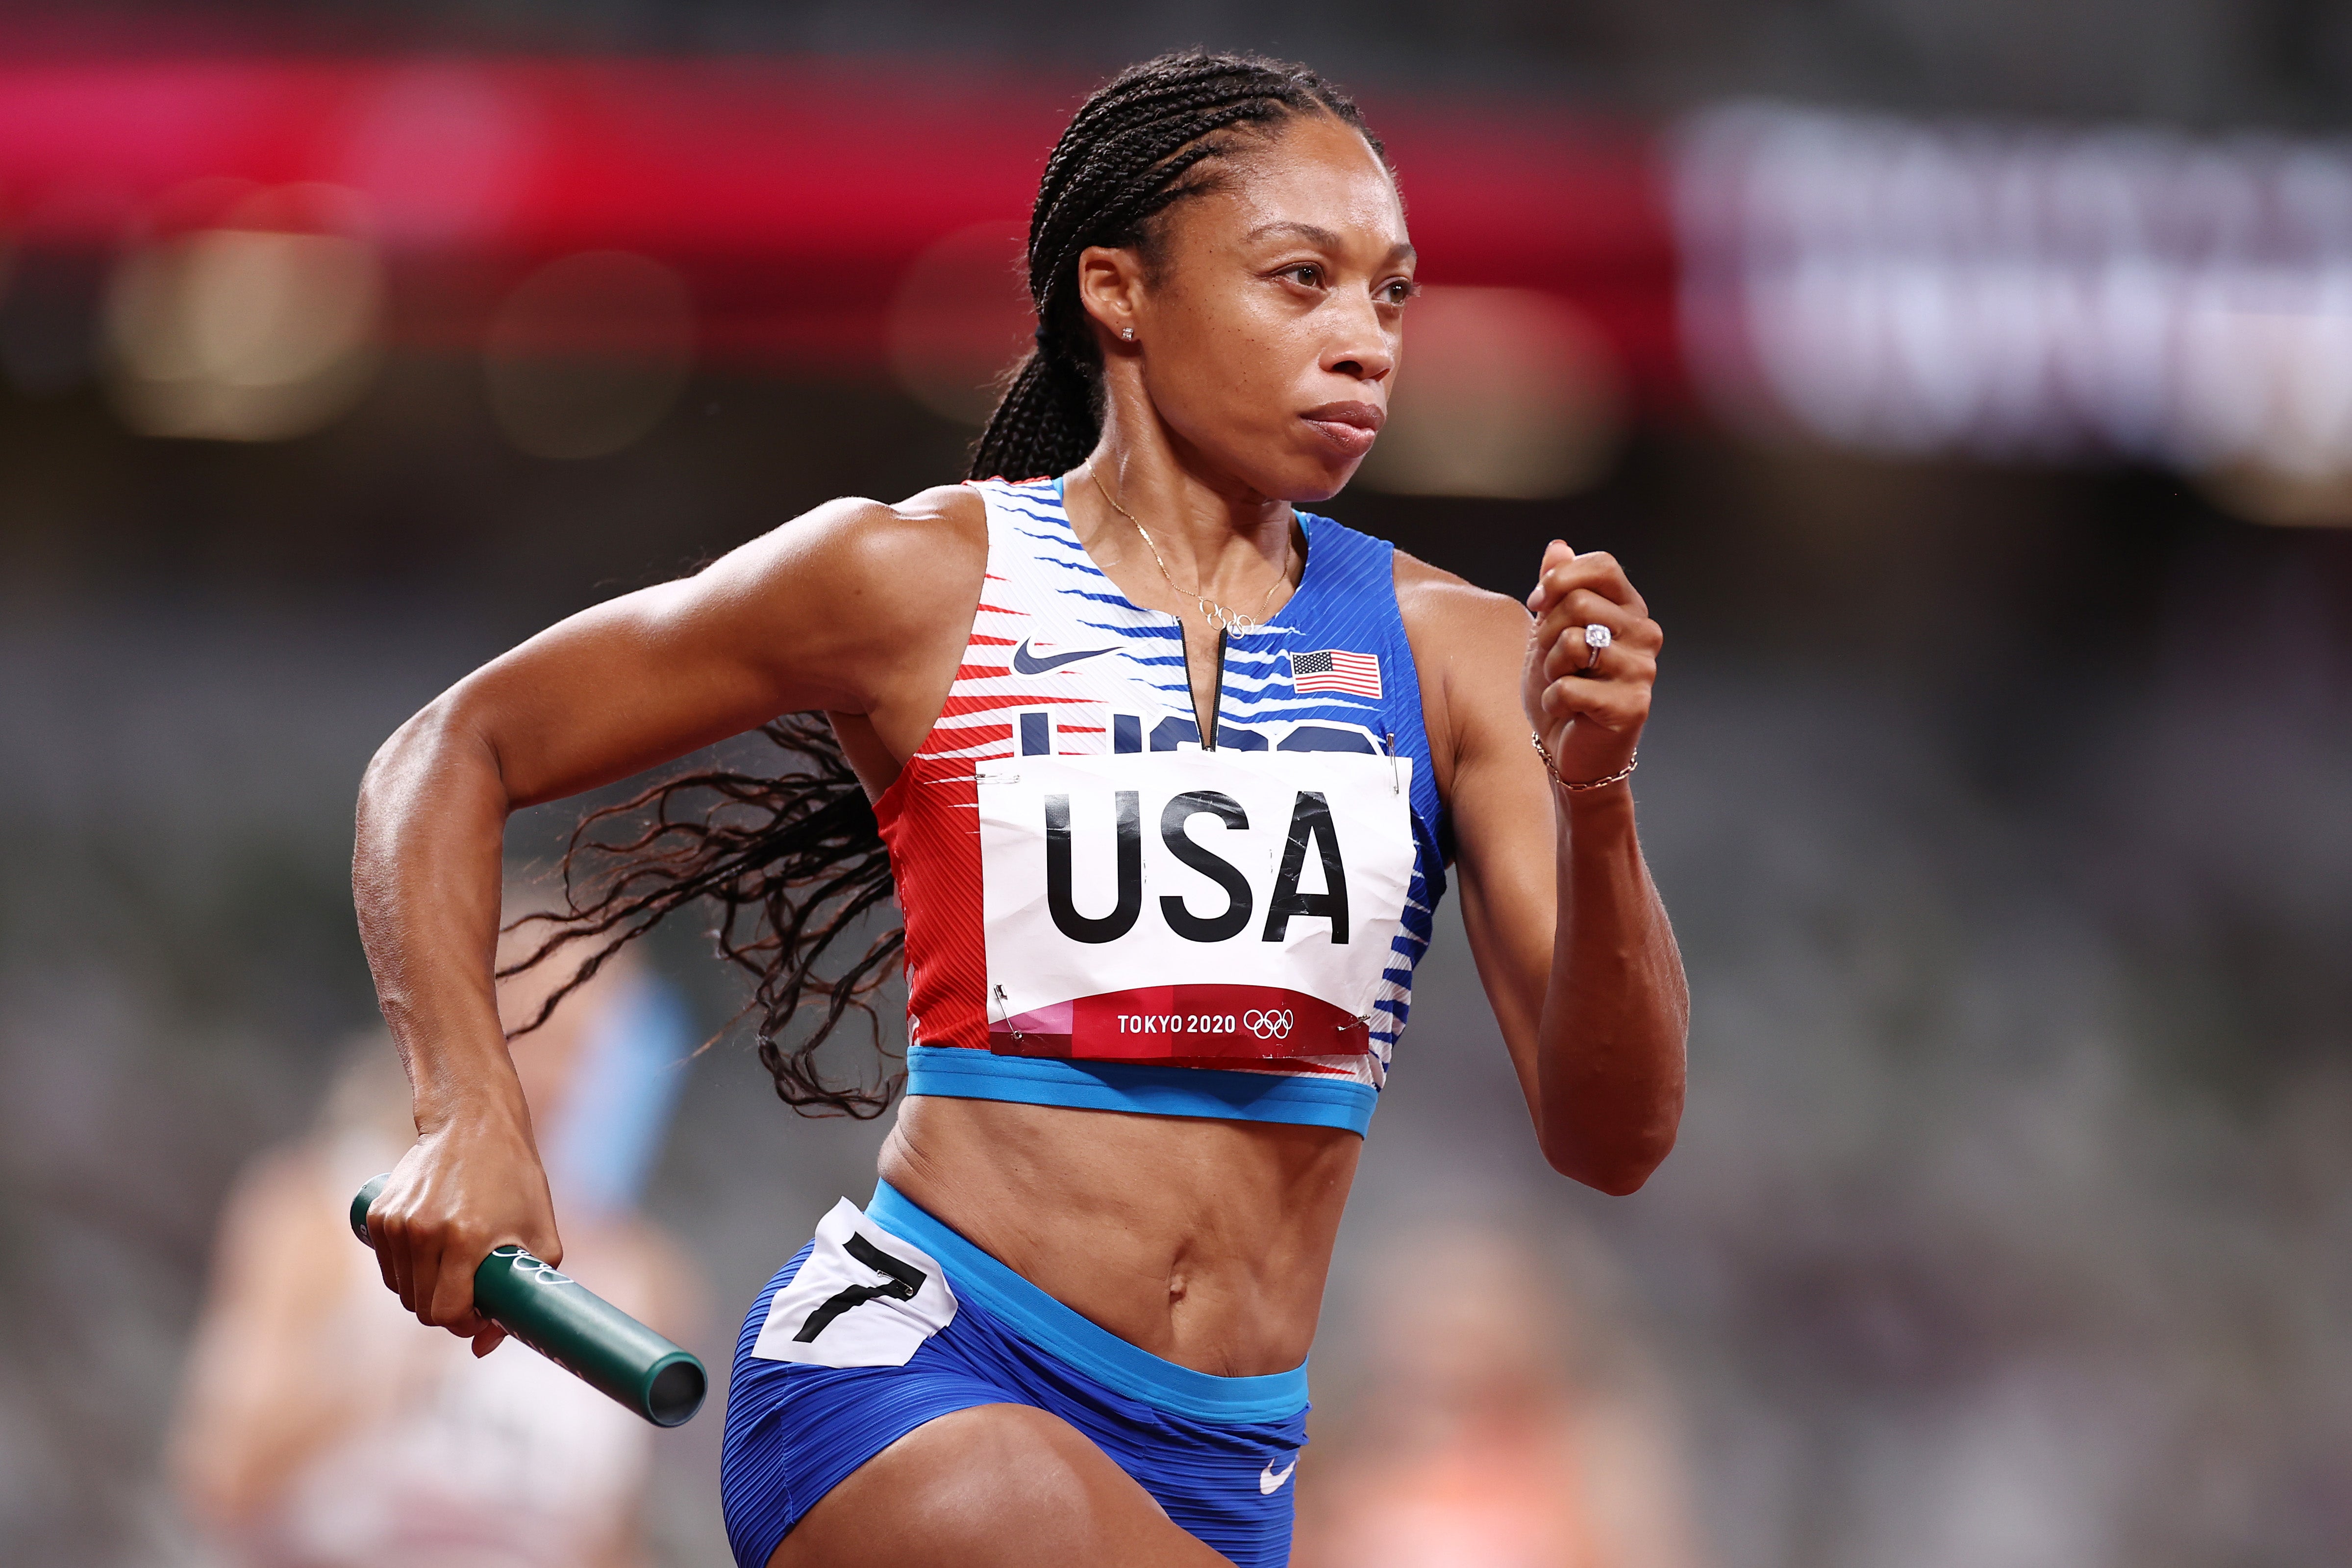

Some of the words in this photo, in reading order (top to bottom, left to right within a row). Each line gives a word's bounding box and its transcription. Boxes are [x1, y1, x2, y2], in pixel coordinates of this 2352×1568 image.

[1044, 790, 1349, 944] USA
[1117, 1015, 1182, 1034] TOKYO
[1187, 1015, 1236, 1033] 2020
[792, 1231, 927, 1343] 7
